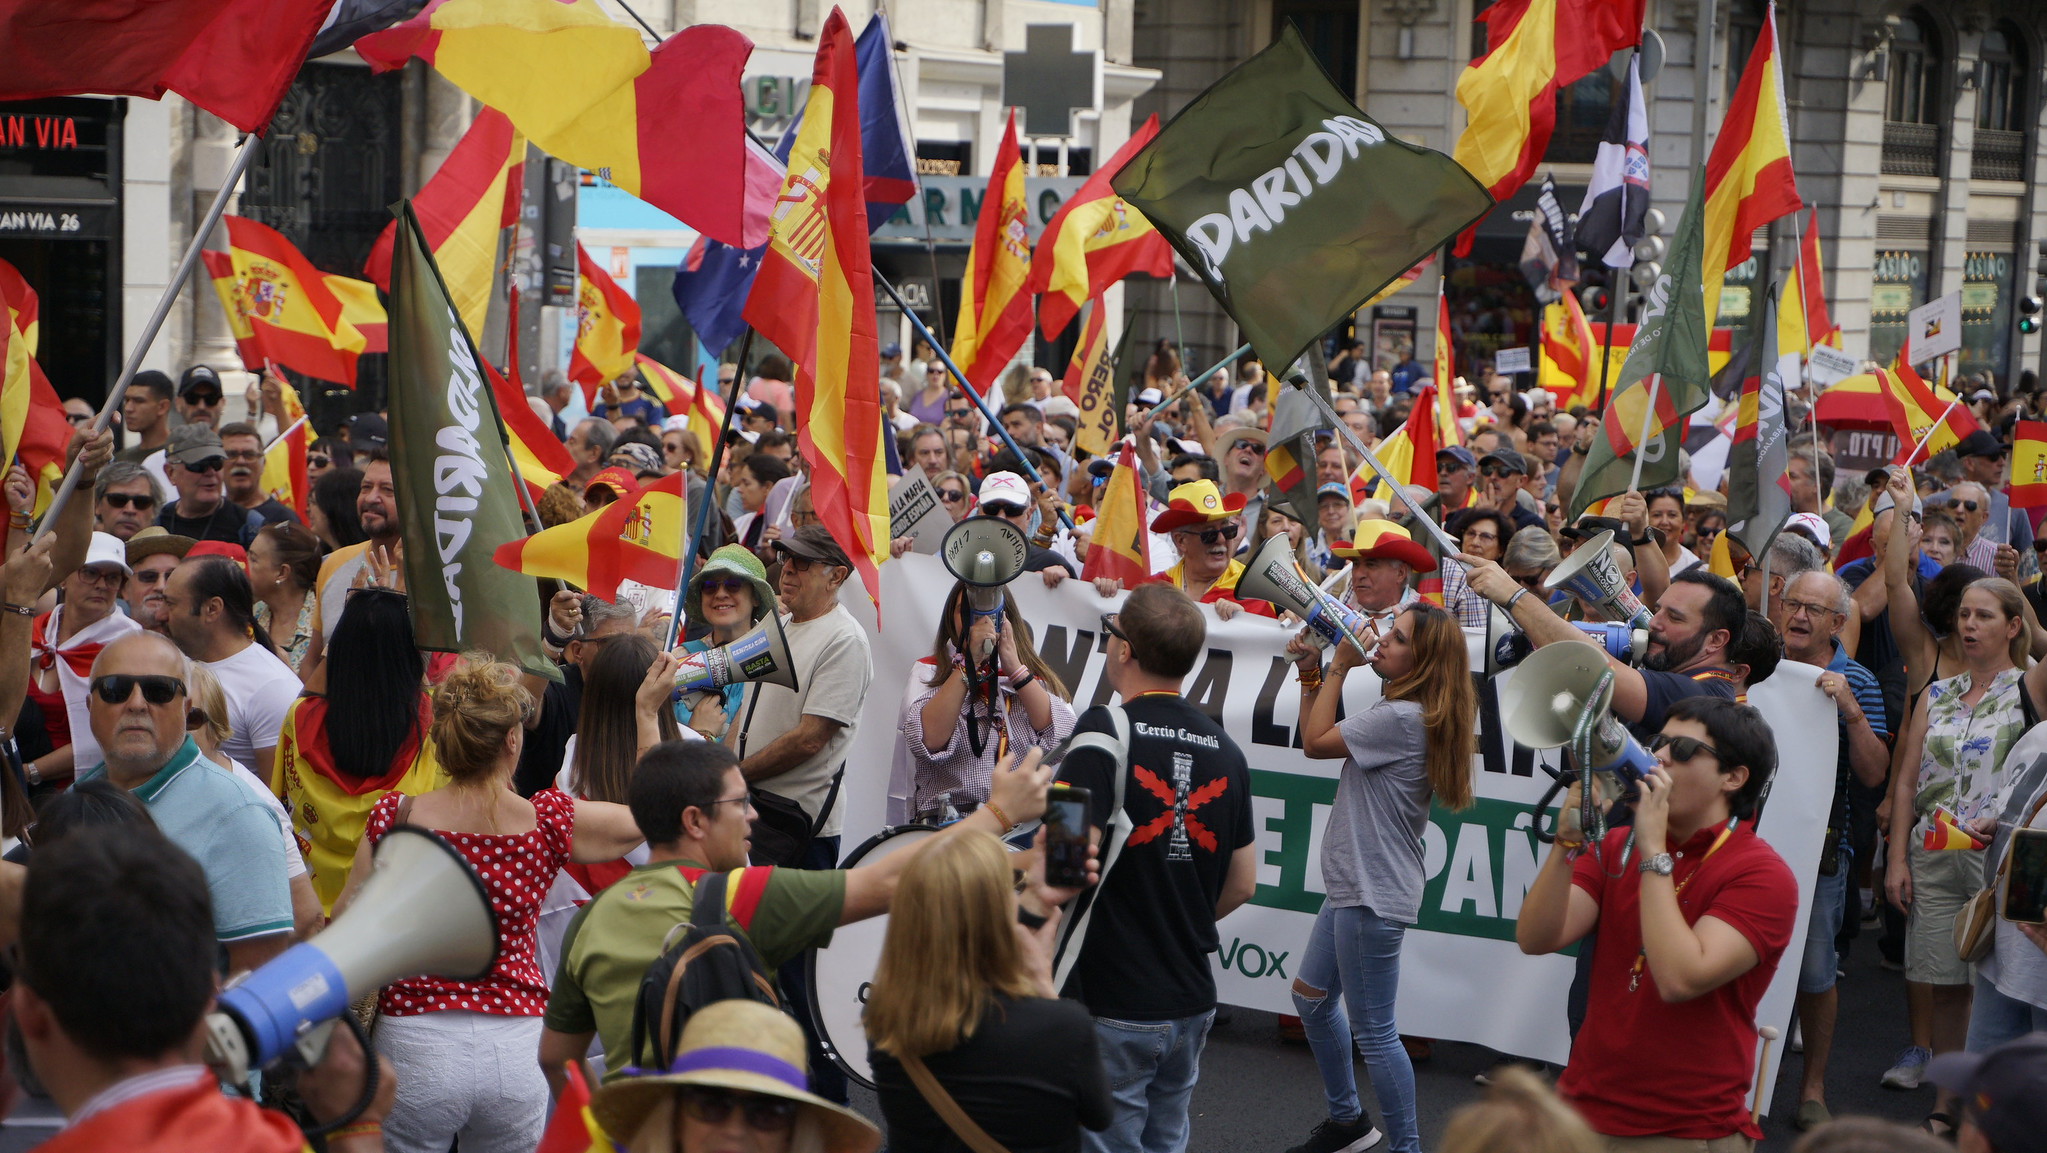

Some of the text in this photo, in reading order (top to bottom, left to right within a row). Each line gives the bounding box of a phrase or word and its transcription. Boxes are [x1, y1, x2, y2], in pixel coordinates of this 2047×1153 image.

[34, 116, 78, 149] VIA
[0, 211, 81, 232] AN VIA 26
[896, 496, 907, 511] LA
[903, 478, 926, 503] MAFIA
[907, 494, 934, 522] ESPAÑA
[1591, 565, 1615, 596] MERCOSUR
[745, 657, 770, 672] BASTA
[1135, 722, 1176, 738] Tercio
[1217, 937, 1290, 980] VOX
